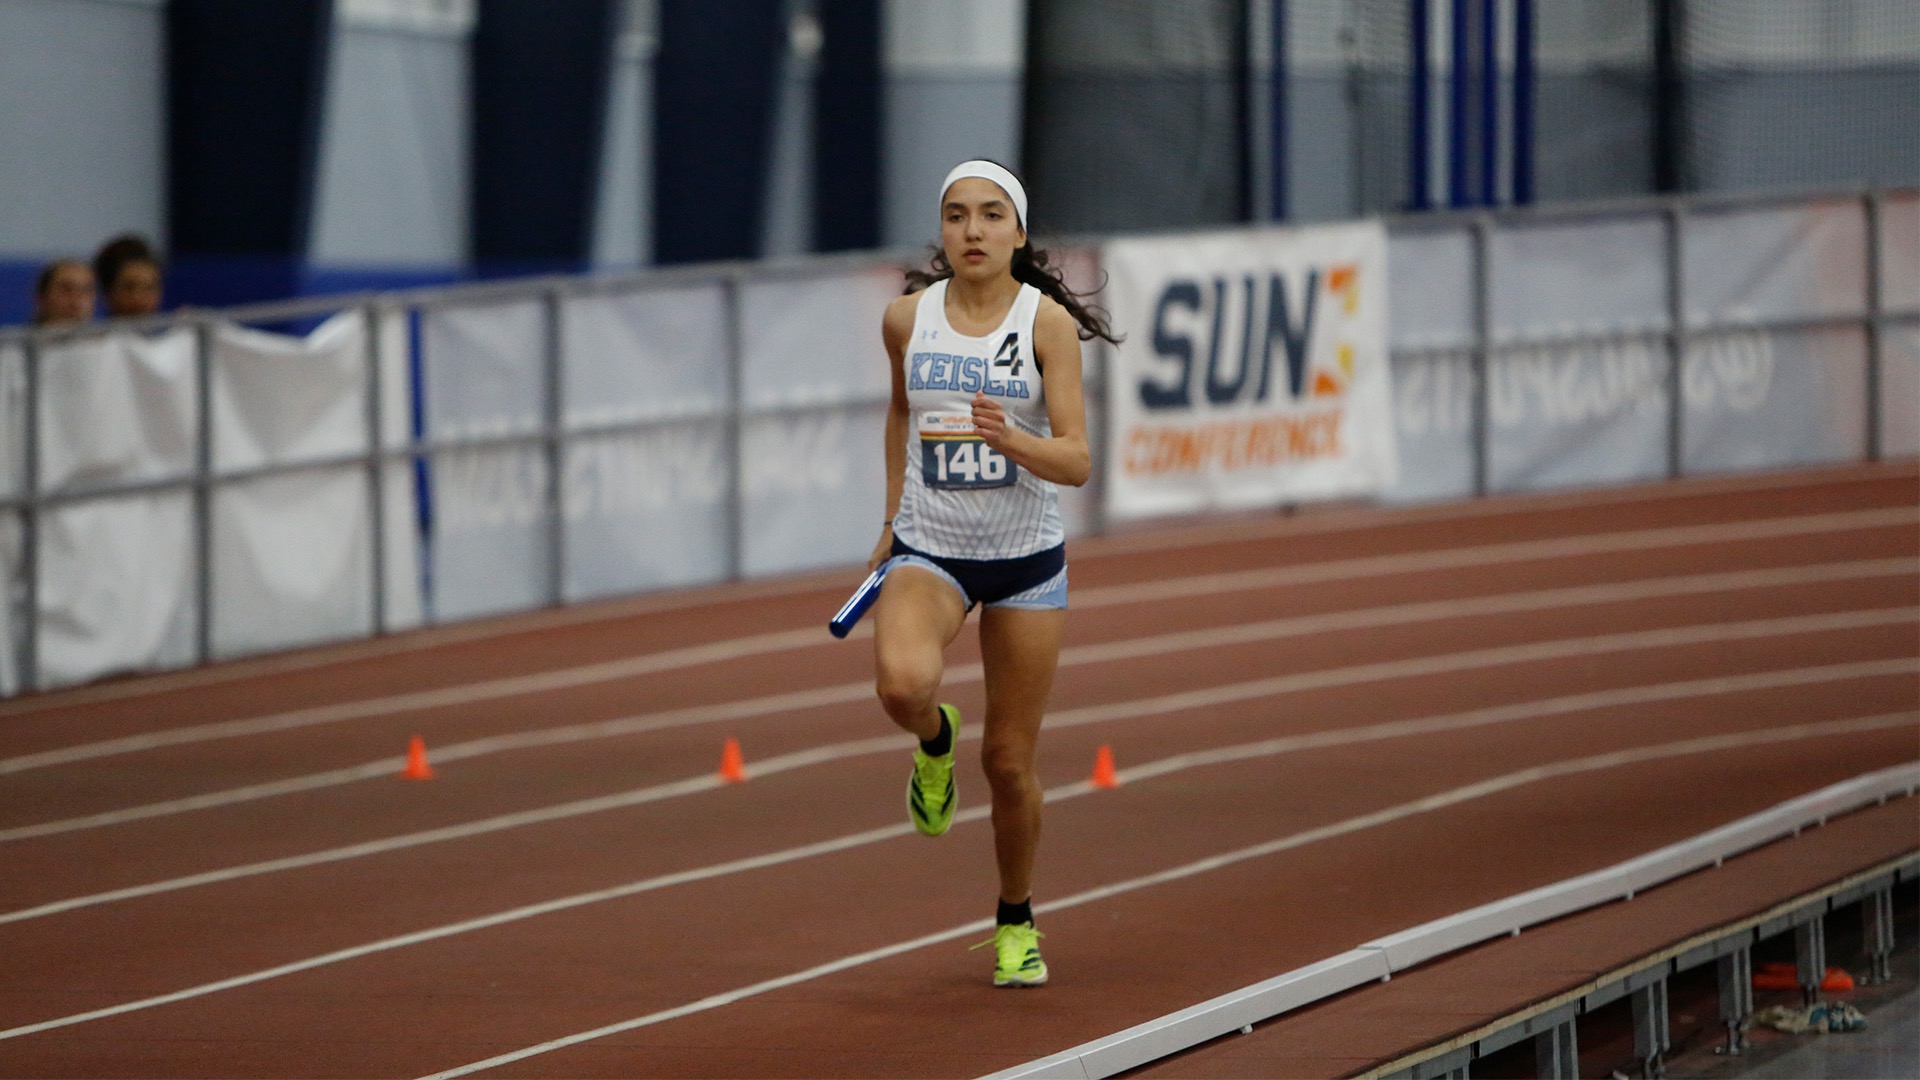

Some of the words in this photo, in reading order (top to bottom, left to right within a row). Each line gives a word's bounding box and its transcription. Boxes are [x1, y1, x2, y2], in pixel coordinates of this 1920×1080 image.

[994, 332, 1024, 377] 4
[1139, 266, 1321, 407] SUN
[933, 442, 1007, 481] 146
[1125, 409, 1344, 476] CONFERENCE
